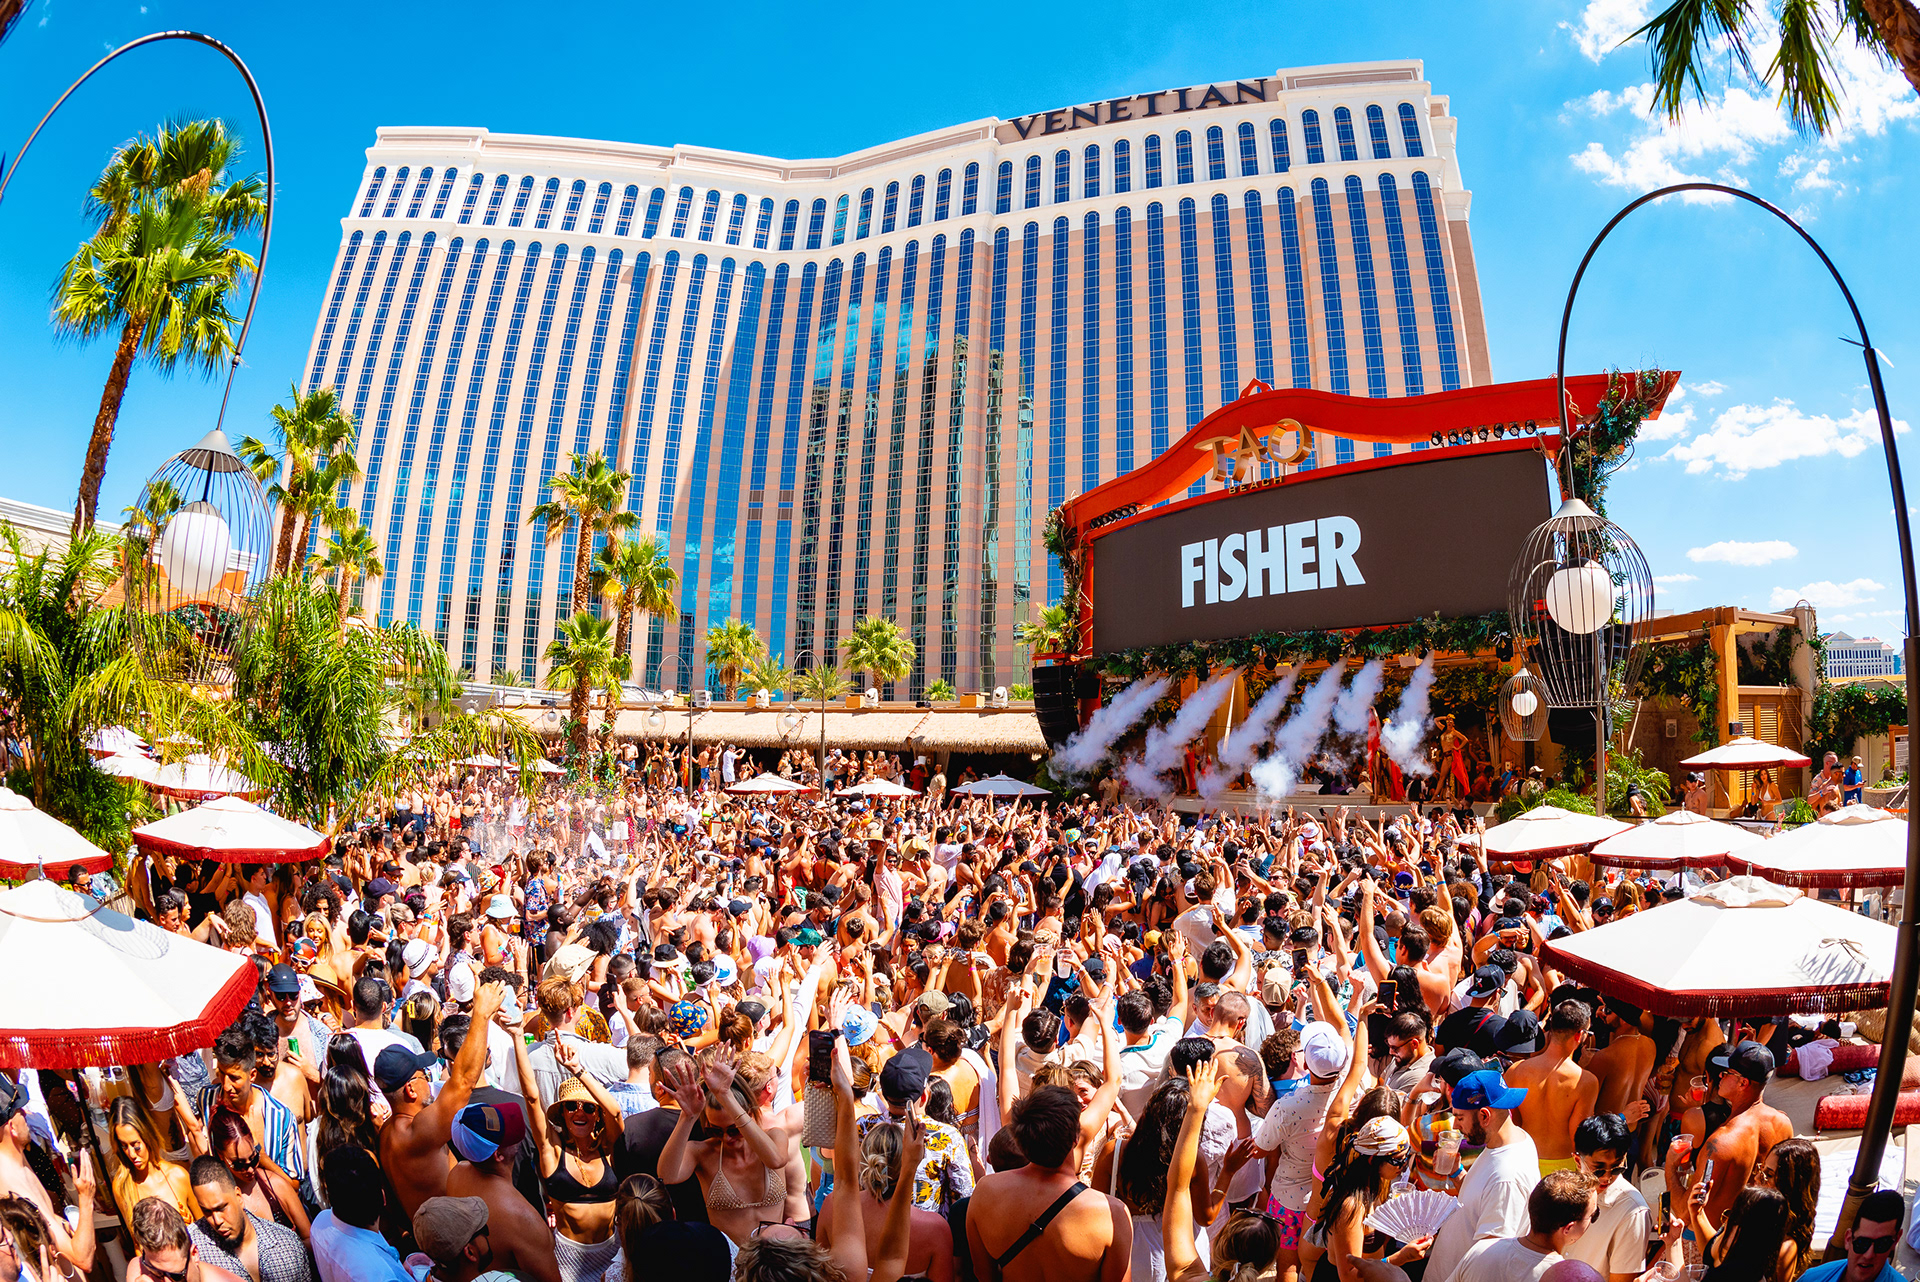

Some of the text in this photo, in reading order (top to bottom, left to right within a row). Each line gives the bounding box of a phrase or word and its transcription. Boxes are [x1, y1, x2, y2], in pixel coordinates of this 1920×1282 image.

[1008, 78, 1268, 140] VENETIAN
[1194, 418, 1312, 482] TAO
[1228, 475, 1284, 495] BEACH
[1181, 515, 1367, 608] FISHER
